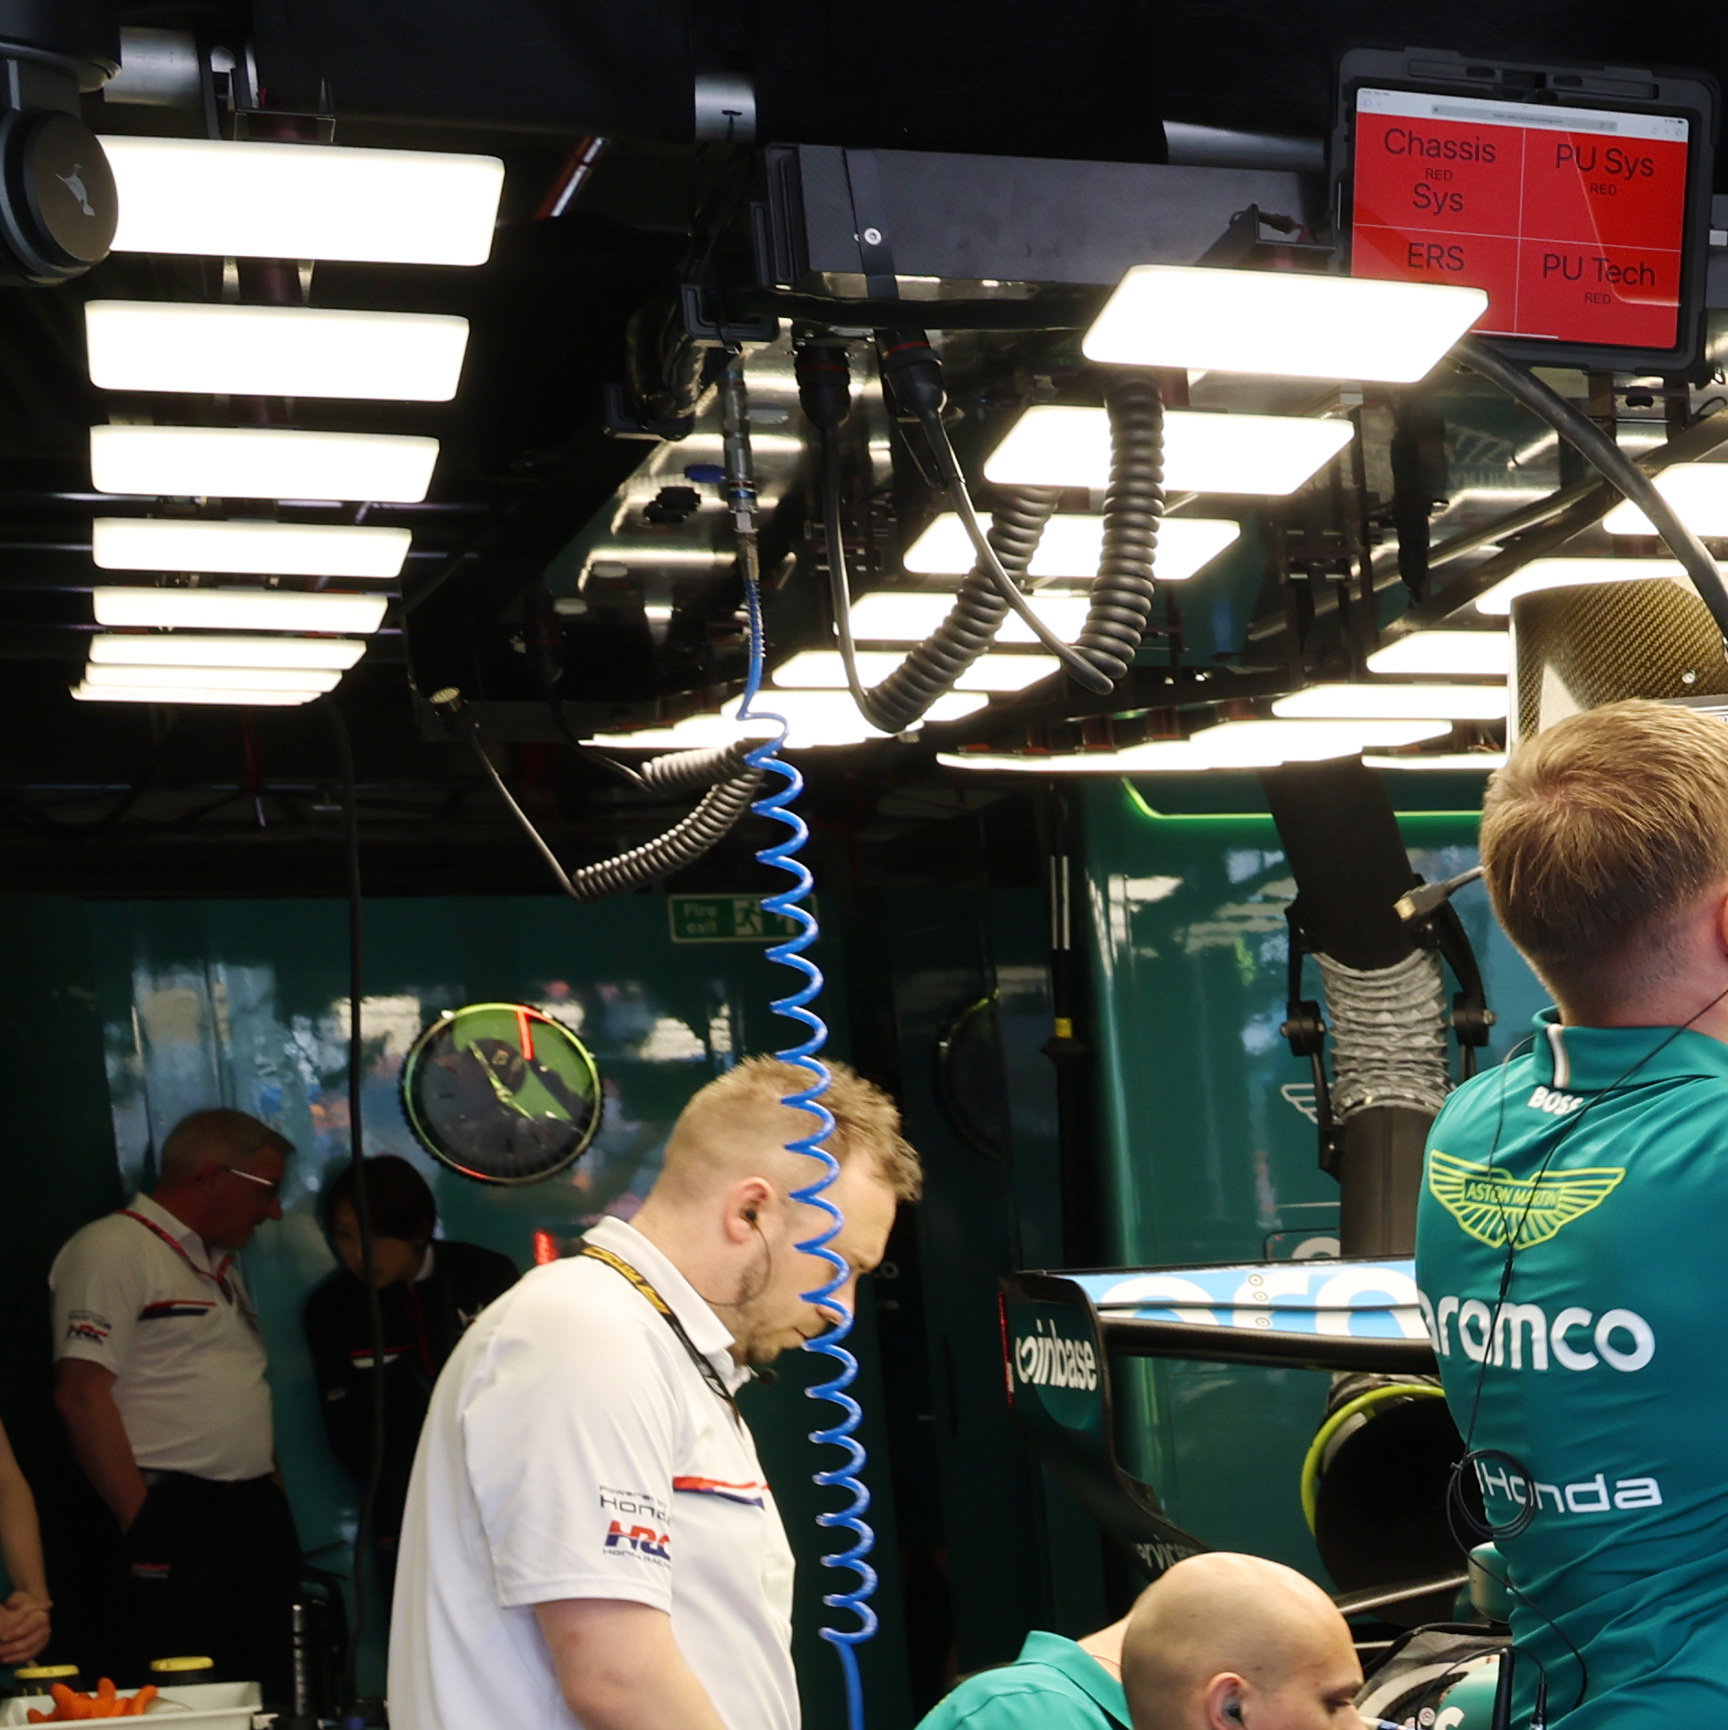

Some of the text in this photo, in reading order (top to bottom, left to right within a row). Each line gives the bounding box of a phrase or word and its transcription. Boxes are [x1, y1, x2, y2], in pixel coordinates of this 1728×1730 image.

[1384, 127, 1496, 164] Chassis
[1555, 143, 1655, 181] PU Sys
[1425, 167, 1454, 182] RED
[1590, 182, 1617, 196] RED
[1411, 182, 1464, 215] Sys
[1407, 242, 1465, 272] ERS
[1542, 254, 1655, 287] PU Tech
[1584, 291, 1612, 306] RED
[1528, 1086, 1583, 1116] BOSS
[1466, 1180, 1561, 1208] ASTON MARTIN
[1015, 1319, 1098, 1391] coinbase
[1483, 1465, 1663, 1514] Honda
[605, 1519, 671, 1562] HRC
